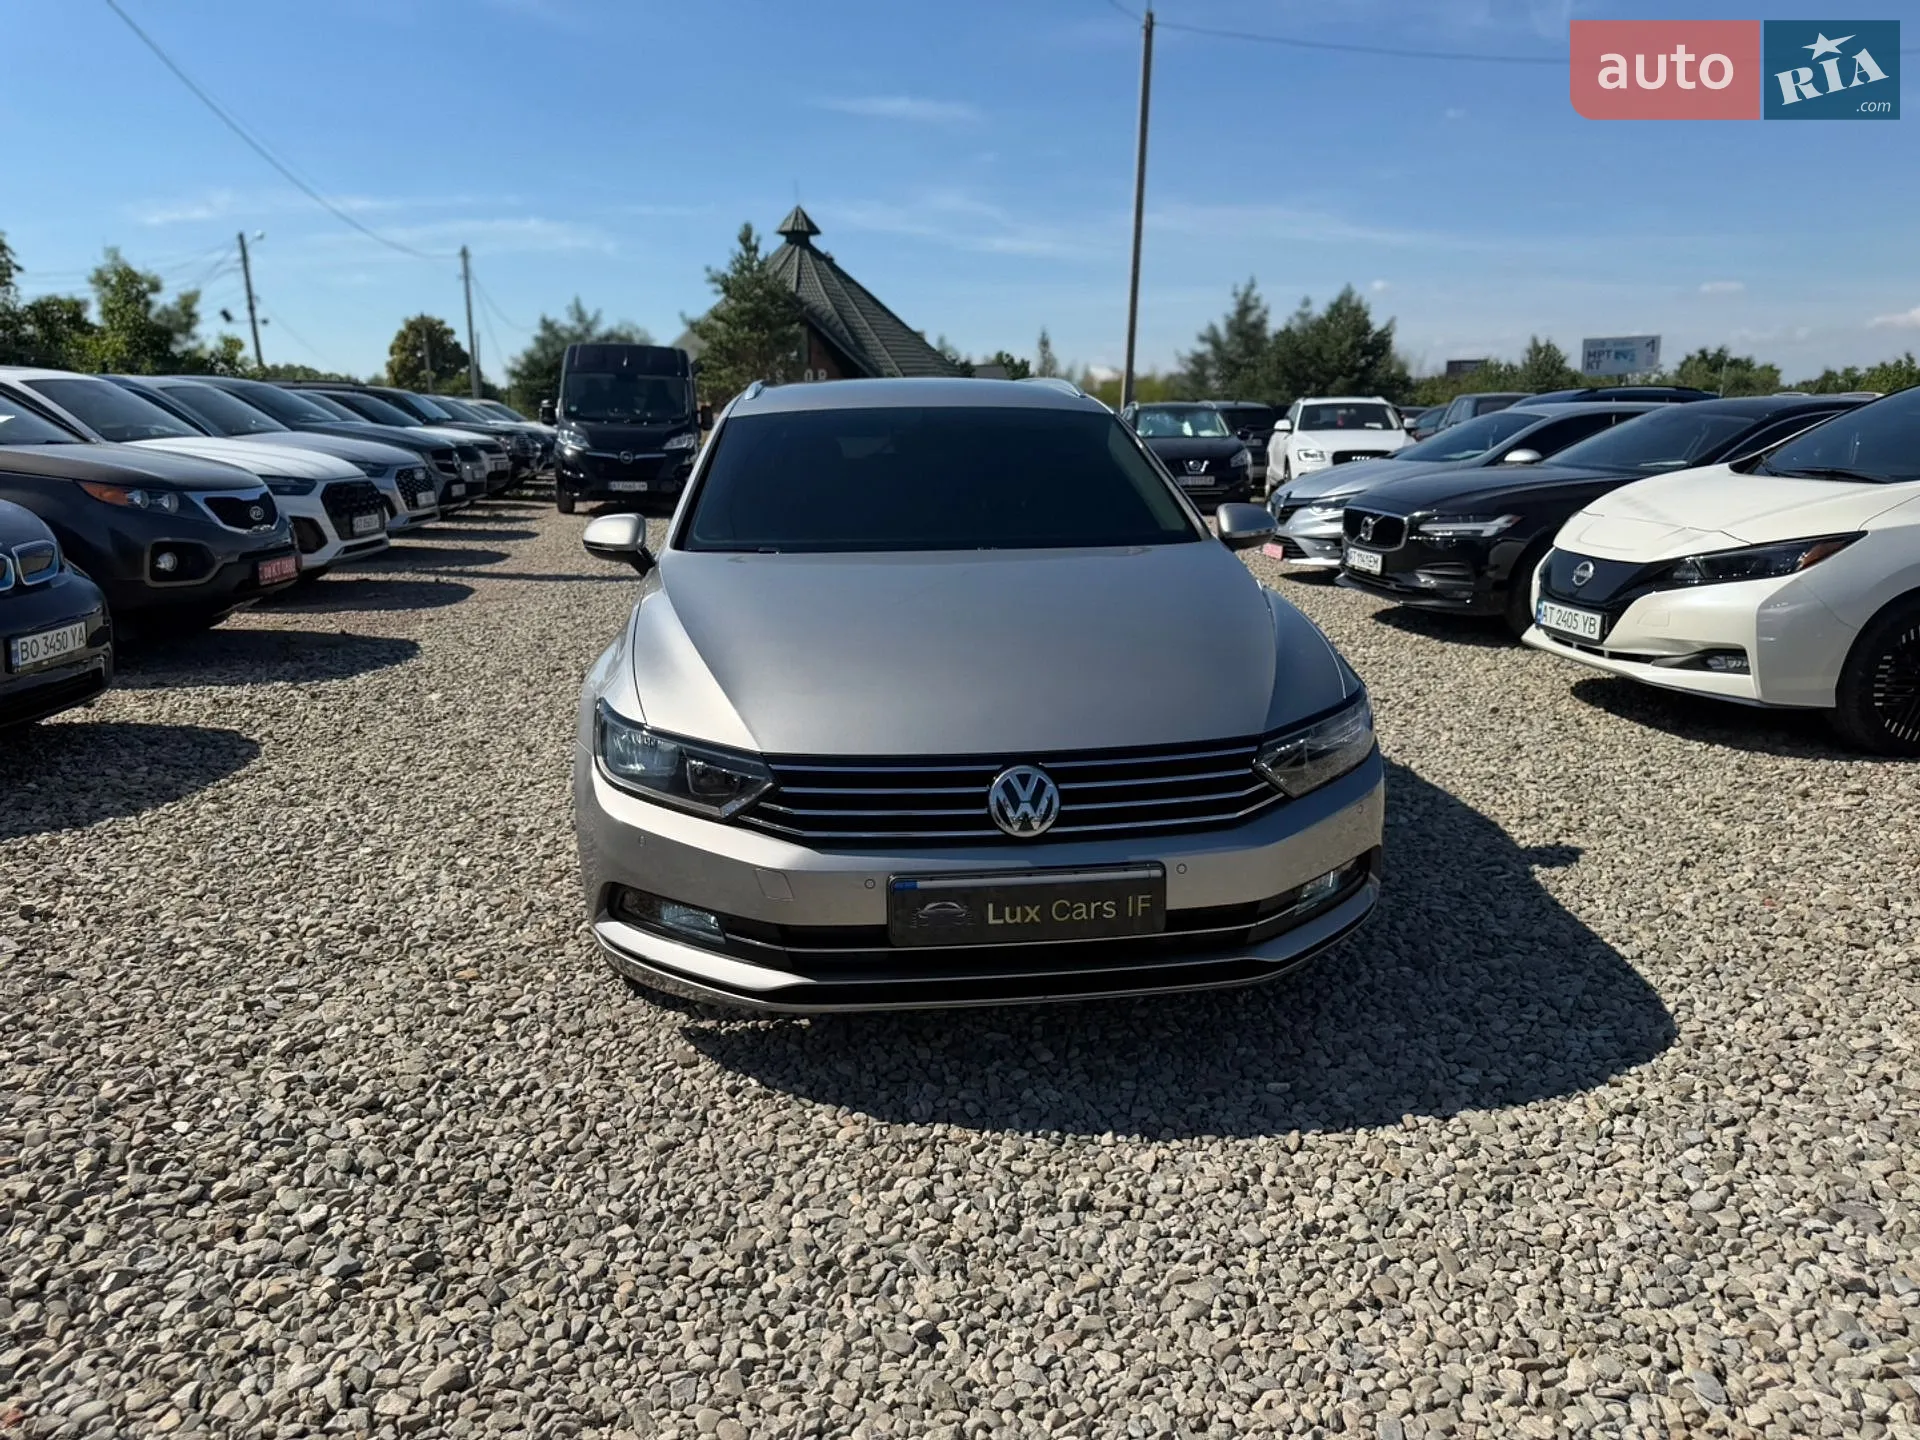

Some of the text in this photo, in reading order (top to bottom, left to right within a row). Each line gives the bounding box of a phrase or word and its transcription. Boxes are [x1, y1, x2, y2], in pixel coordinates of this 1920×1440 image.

[1543, 605, 1597, 635] AT 2405 YB
[20, 624, 85, 661] BO 3450 YA
[987, 894, 1153, 925] Lux Cars IF
